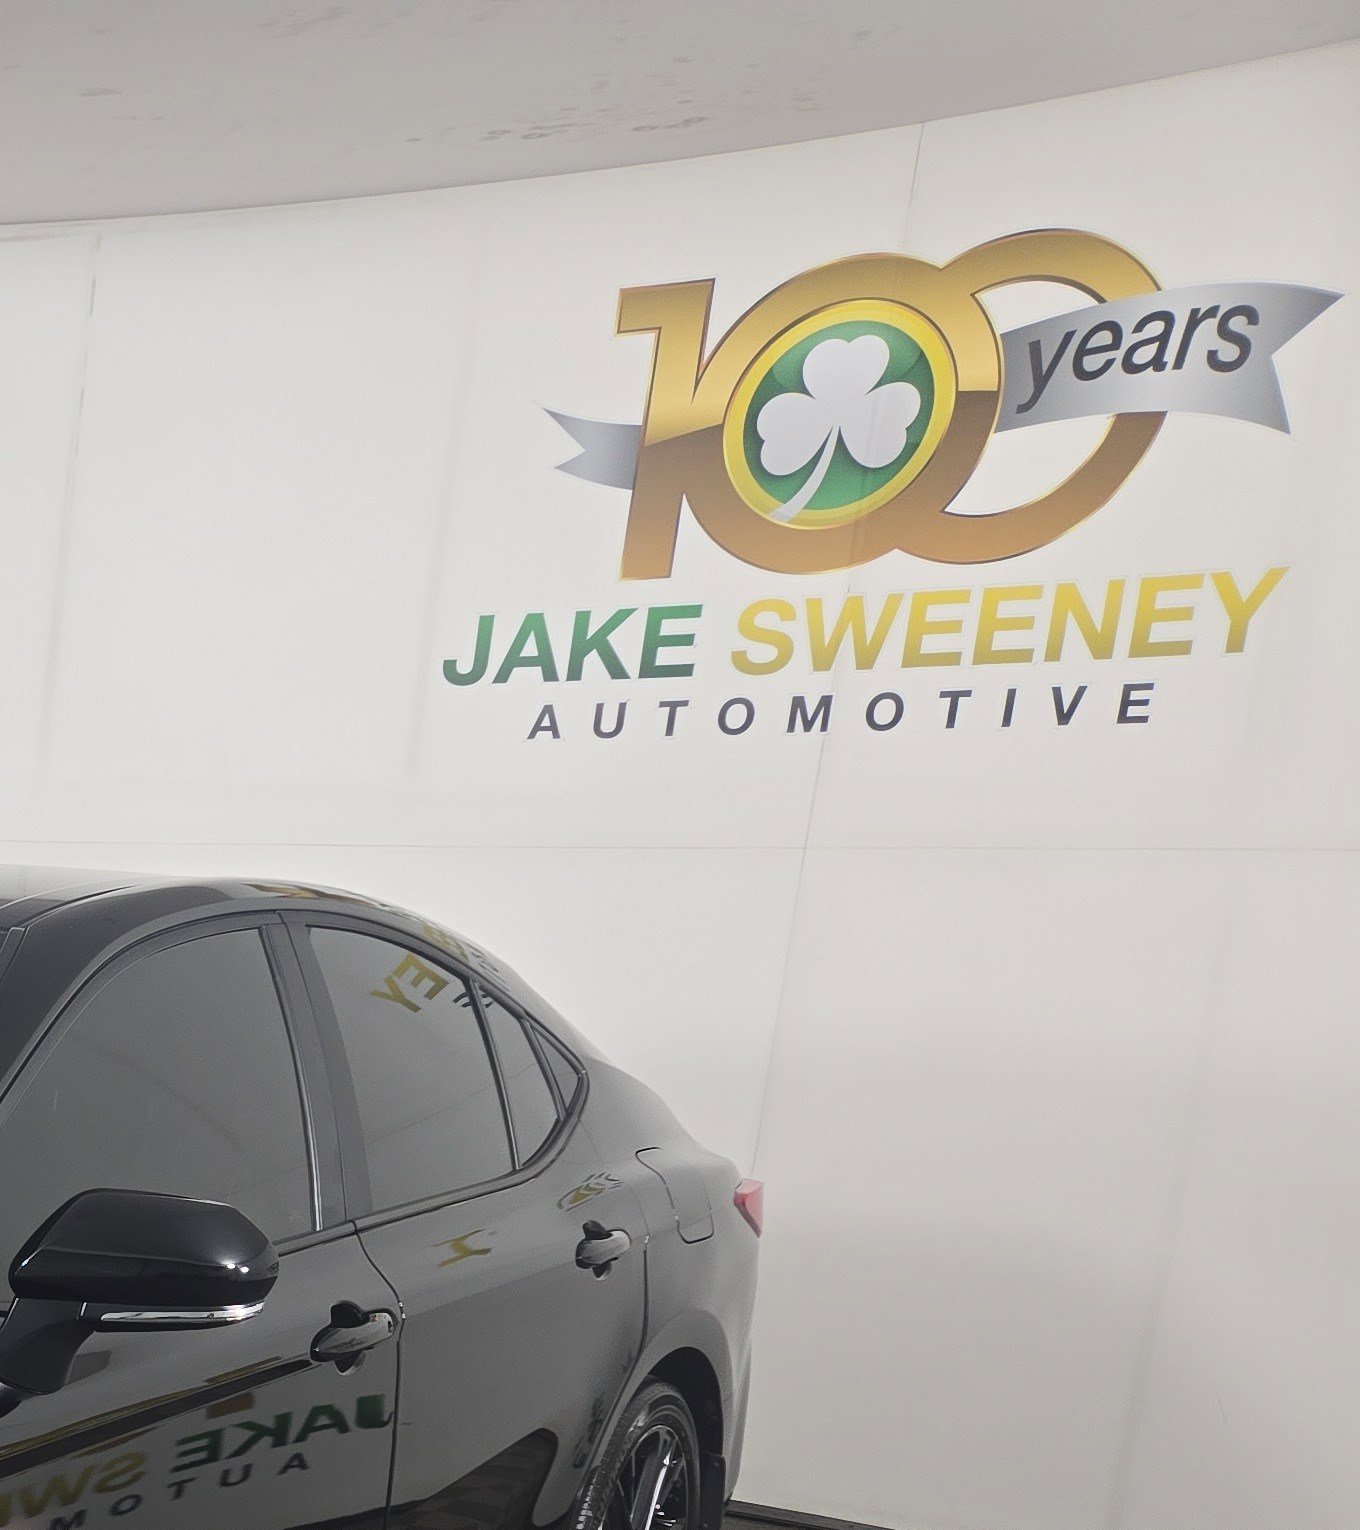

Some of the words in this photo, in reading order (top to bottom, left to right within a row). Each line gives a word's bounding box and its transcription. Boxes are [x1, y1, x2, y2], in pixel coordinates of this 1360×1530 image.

[616, 228, 1168, 581] 100
[1016, 301, 1260, 415] years
[442, 603, 704, 688] JAKE
[730, 565, 1290, 677] SWEENEY
[527, 681, 1156, 741] AUTOMOTIVE
